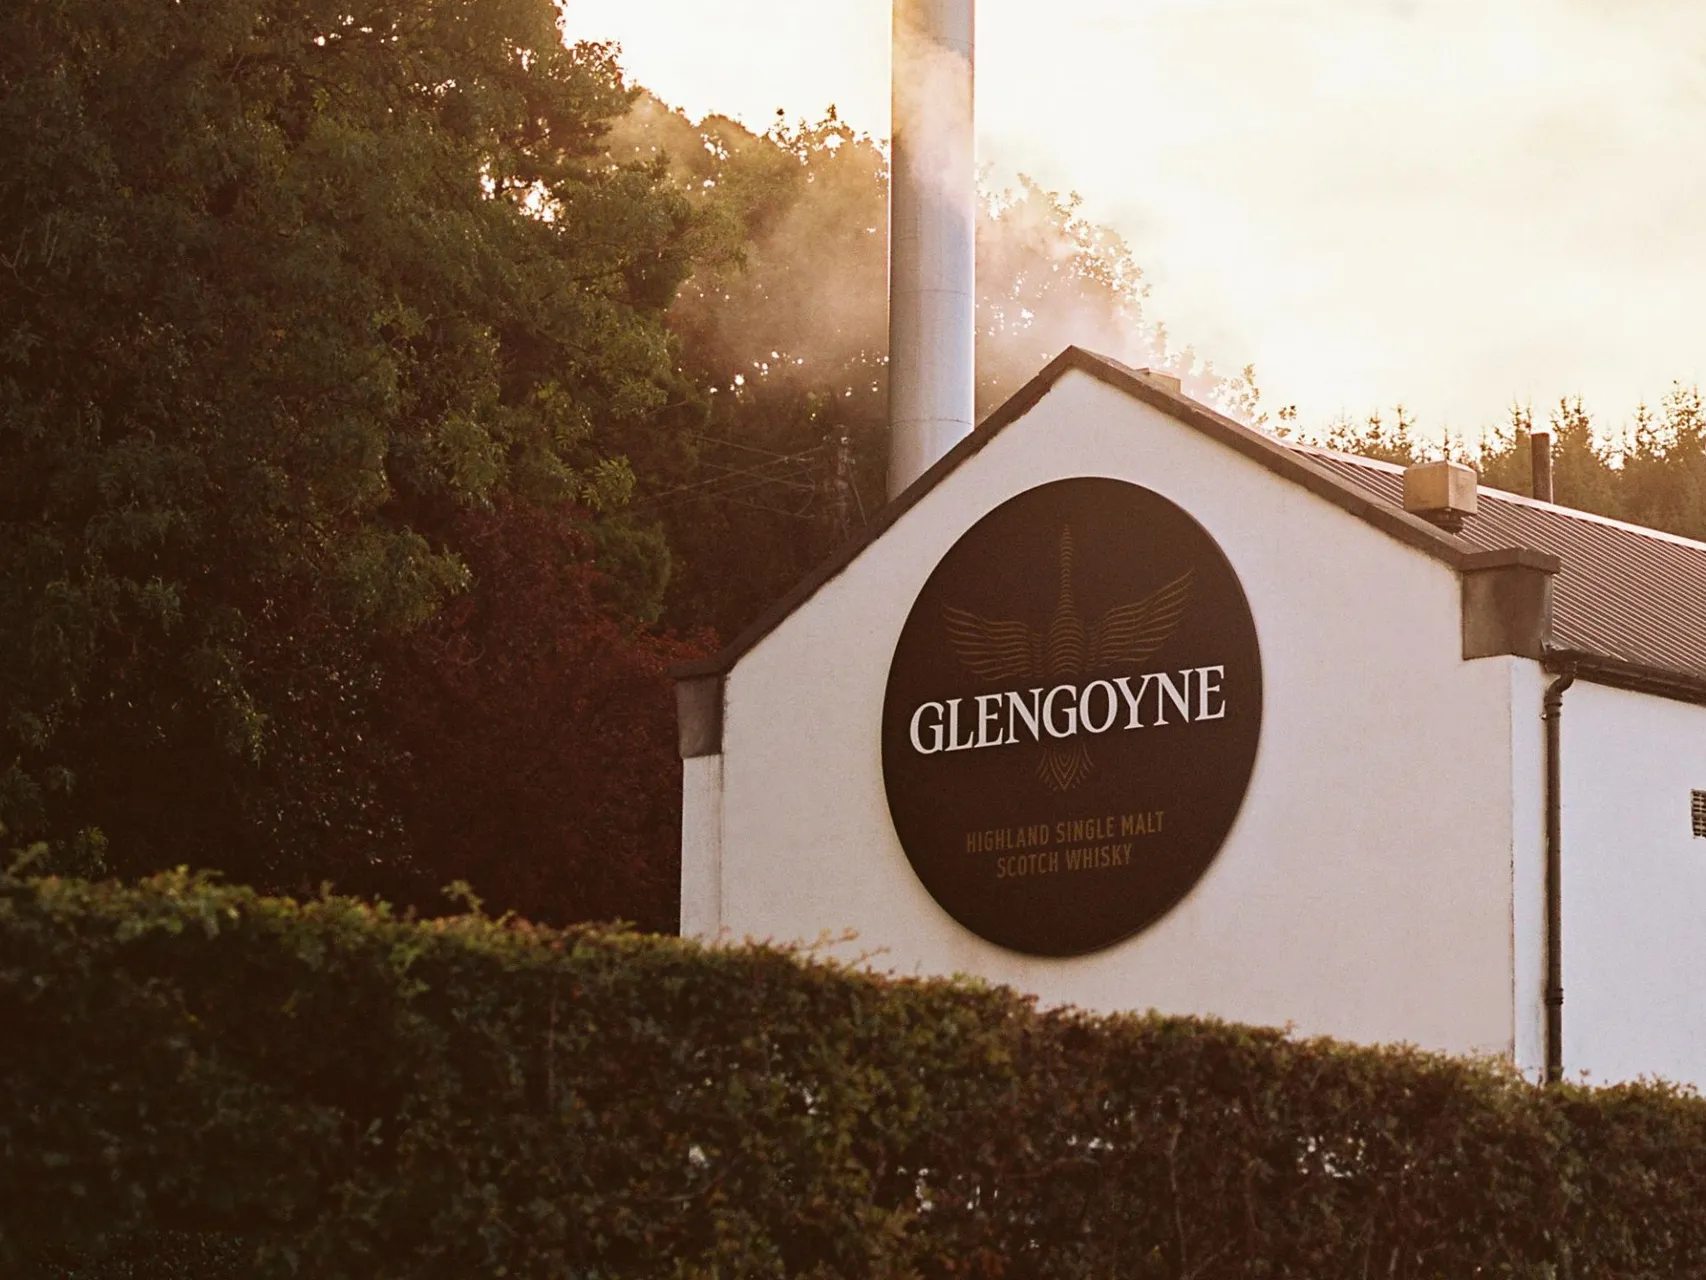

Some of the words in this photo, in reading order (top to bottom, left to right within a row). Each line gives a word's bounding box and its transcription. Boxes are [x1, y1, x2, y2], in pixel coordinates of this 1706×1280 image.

[909, 665, 1226, 755] GLENGOYNE
[966, 824, 1050, 853] HIGHLAND
[1055, 816, 1115, 844] SINGLE
[1120, 810, 1166, 837] MALT
[996, 851, 1060, 880] SCOTCH
[1065, 843, 1134, 872] WHISKY
